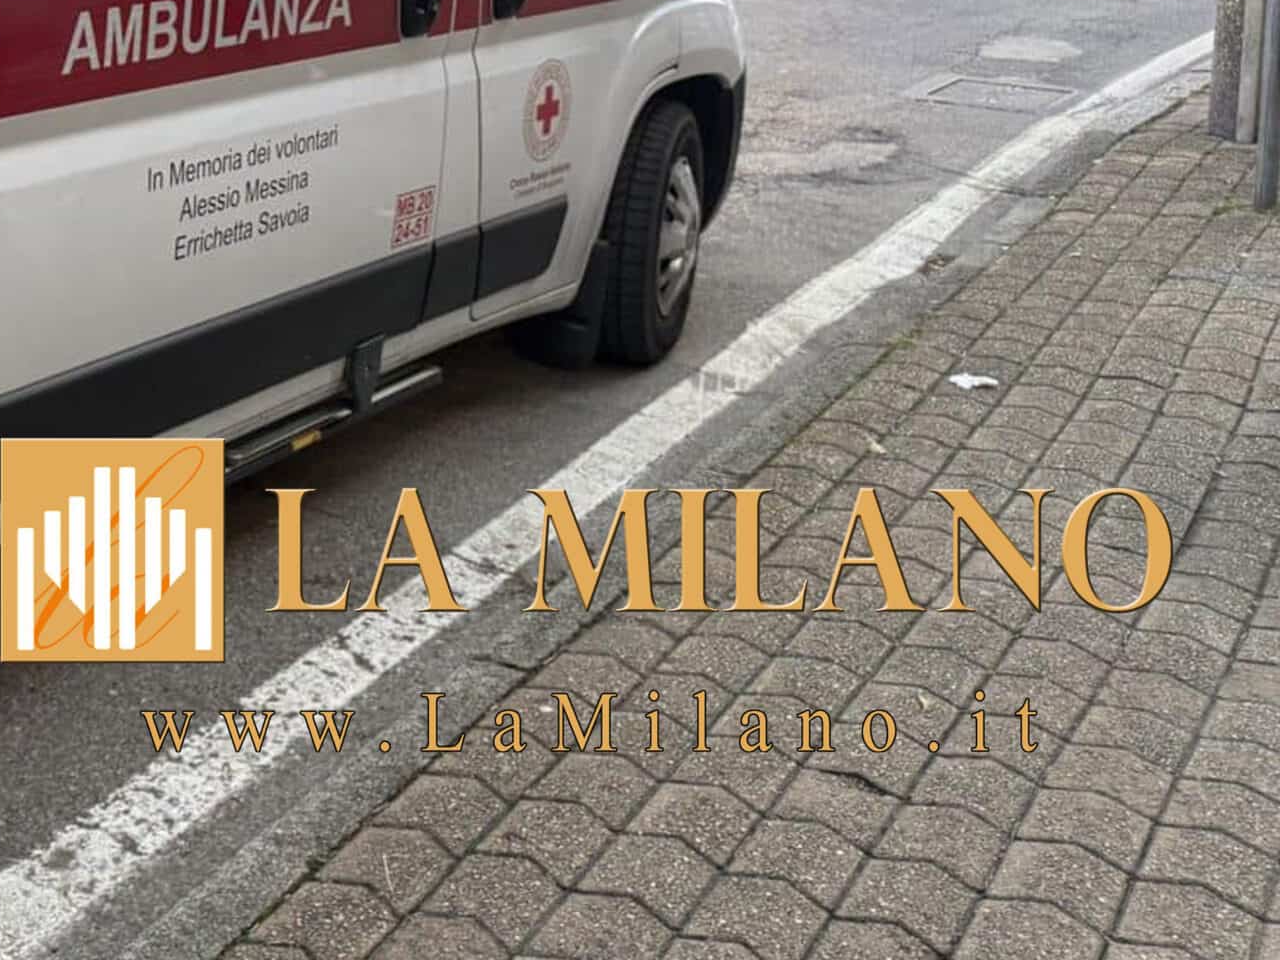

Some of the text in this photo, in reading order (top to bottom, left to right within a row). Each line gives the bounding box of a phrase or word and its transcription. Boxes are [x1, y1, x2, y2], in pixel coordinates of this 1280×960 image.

[146, 124, 339, 192] In Memoria dei volontari
[179, 170, 309, 222] Alessio Messina
[174, 202, 310, 261] Errichetta Savoia
